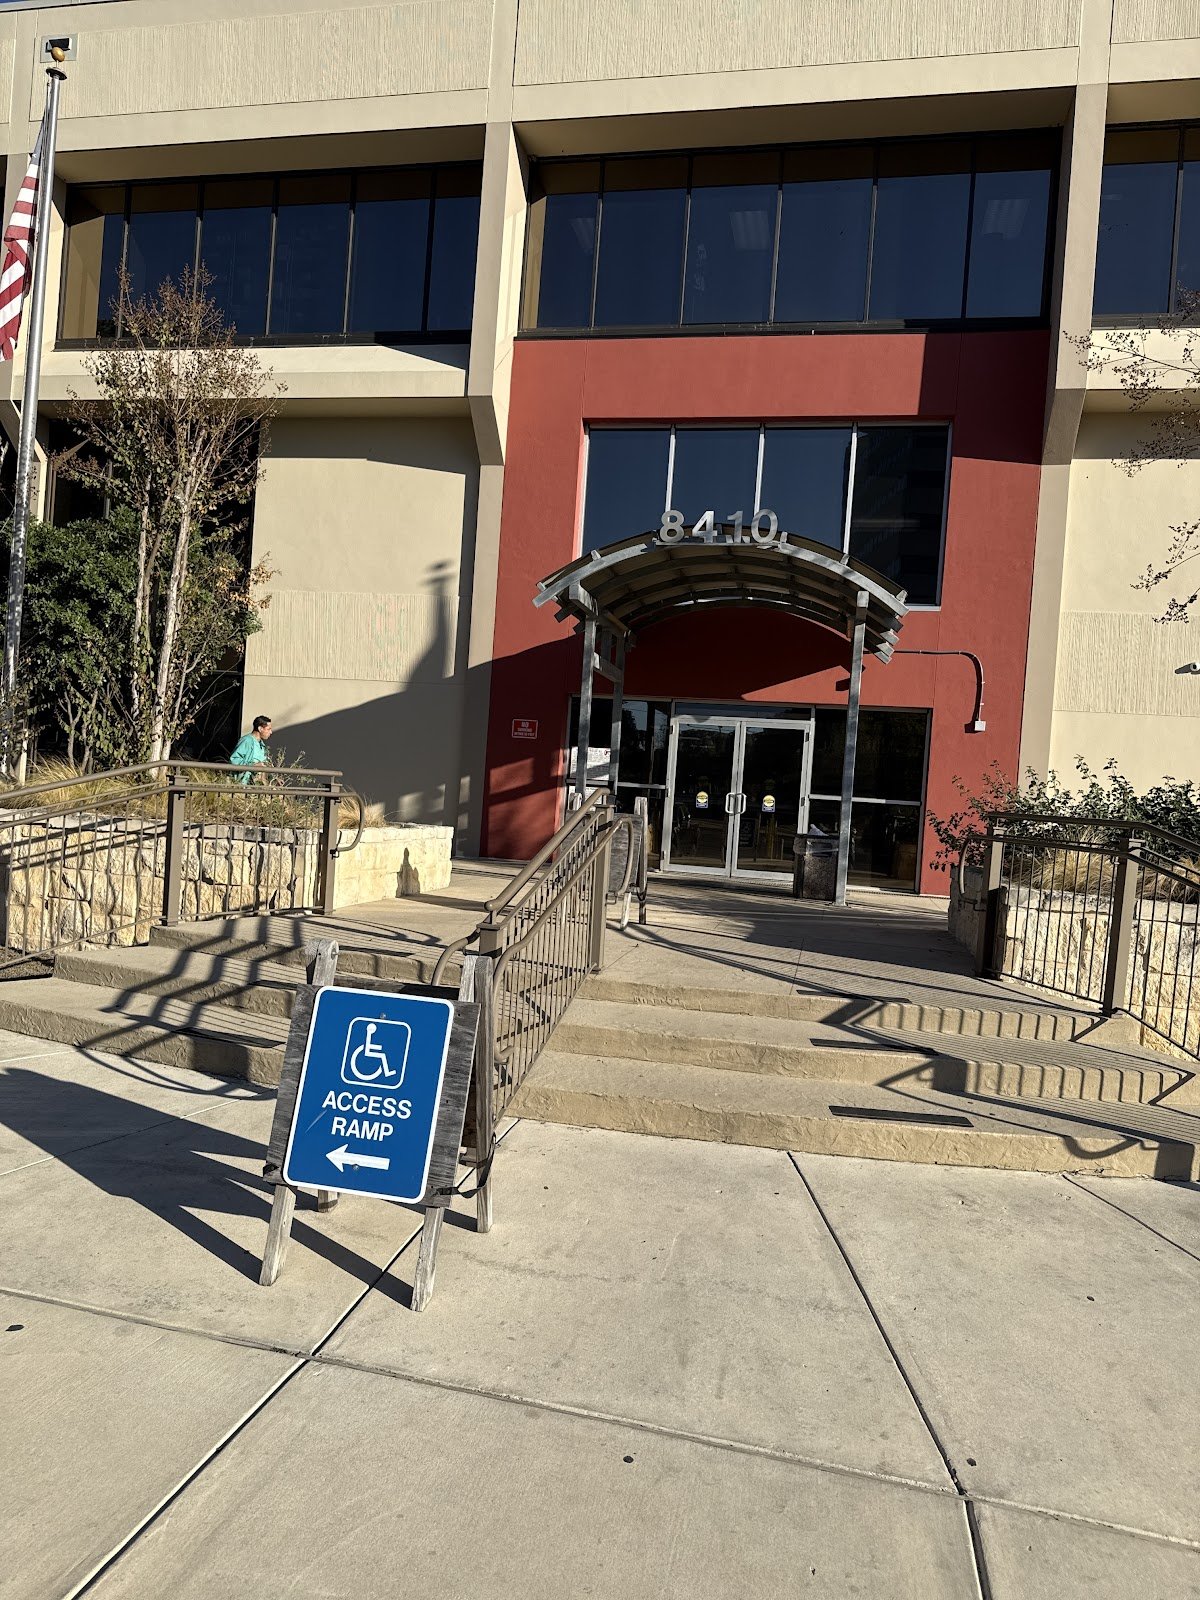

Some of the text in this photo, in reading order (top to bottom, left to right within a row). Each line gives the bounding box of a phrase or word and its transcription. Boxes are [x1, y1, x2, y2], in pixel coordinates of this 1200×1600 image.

[660, 509, 778, 543] 8410
[321, 1090, 412, 1119] ACCESS
[331, 1116, 394, 1142] RAMP
